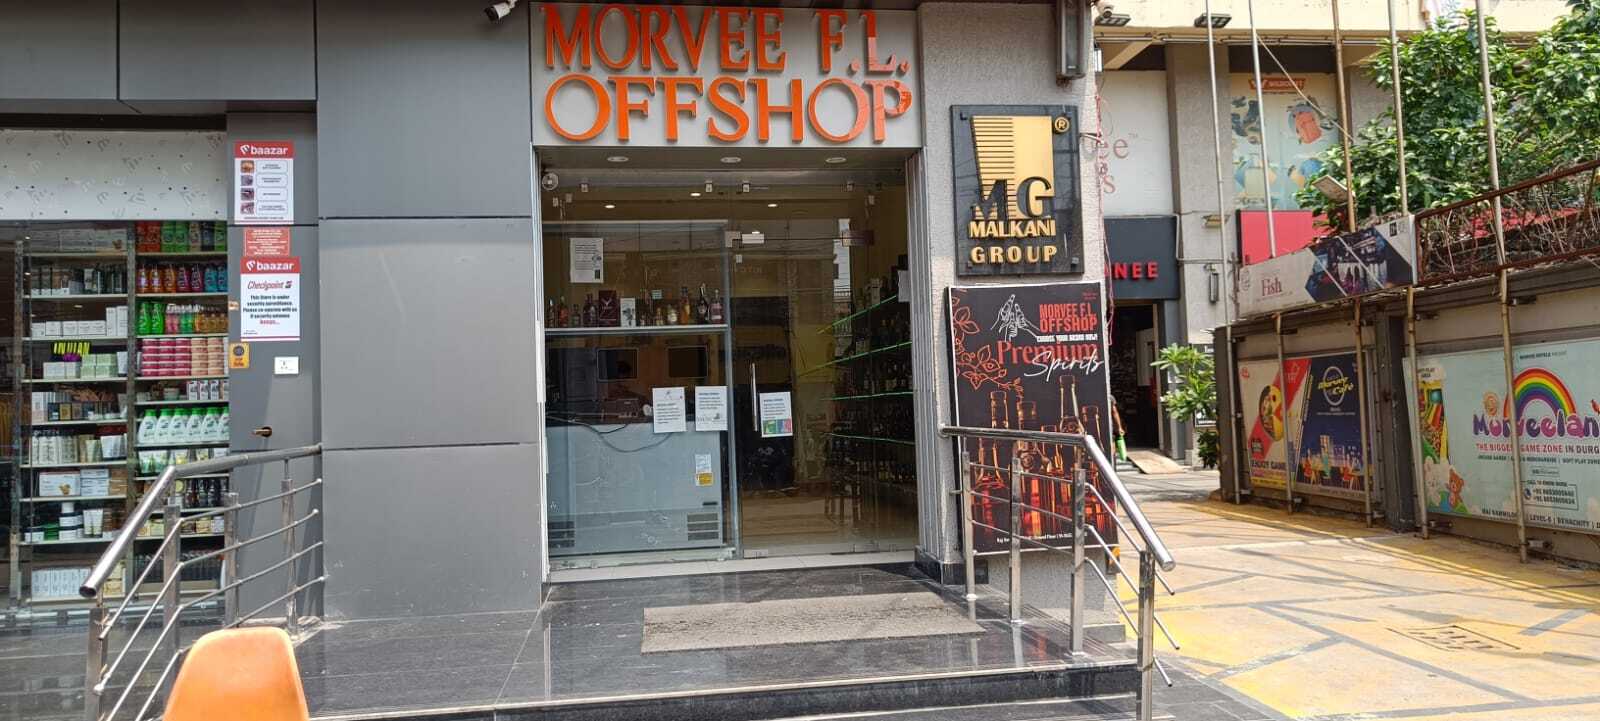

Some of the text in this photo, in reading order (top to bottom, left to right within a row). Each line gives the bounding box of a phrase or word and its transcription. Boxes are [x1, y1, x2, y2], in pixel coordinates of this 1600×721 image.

[541, 3, 911, 75] MORVEE F.L.
[544, 74, 913, 143] OFFSHOP
[969, 220, 1057, 238] MALKANI
[970, 245, 1058, 265] GROUP
[1105, 261, 1159, 279] NEE
[1039, 303, 1078, 319] MORVEE
[1039, 314, 1098, 333] OFFSHOP
[996, 340, 1099, 366] Premium
[1024, 348, 1105, 382] Spirits
[1473, 410, 1600, 438] Morveelan
[1542, 443, 1563, 454] ZONE
